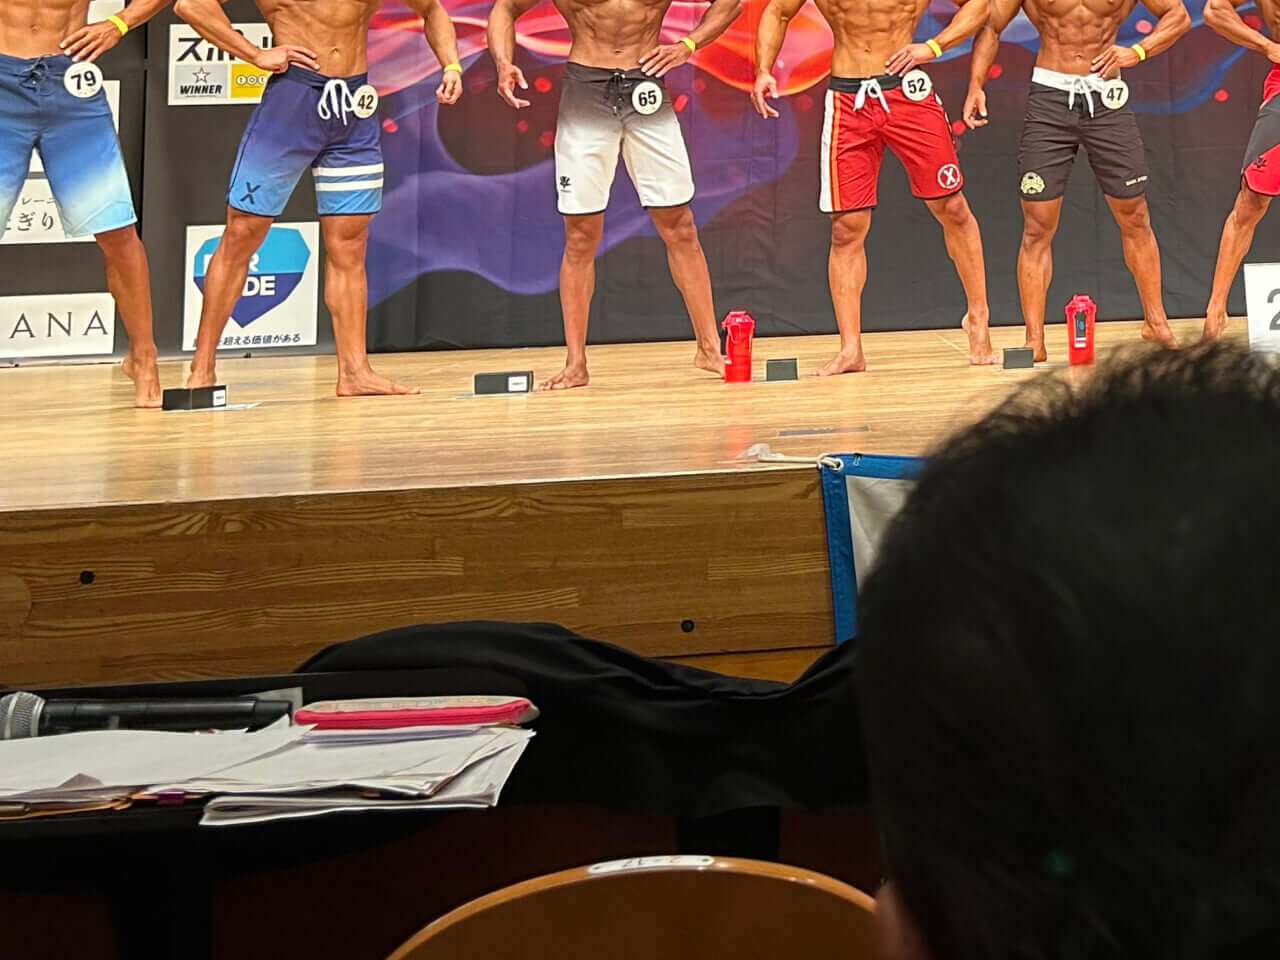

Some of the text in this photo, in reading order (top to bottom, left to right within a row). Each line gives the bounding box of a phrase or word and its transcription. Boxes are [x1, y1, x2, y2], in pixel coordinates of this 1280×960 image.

[71, 71, 97, 90] 79
[907, 78, 927, 94] 52
[180, 85, 222, 94] WINNER
[1106, 86, 1124, 102] 47
[357, 95, 374, 110] 42
[638, 89, 658, 107] 65
[221, 333, 301, 346] 超える価値がある
